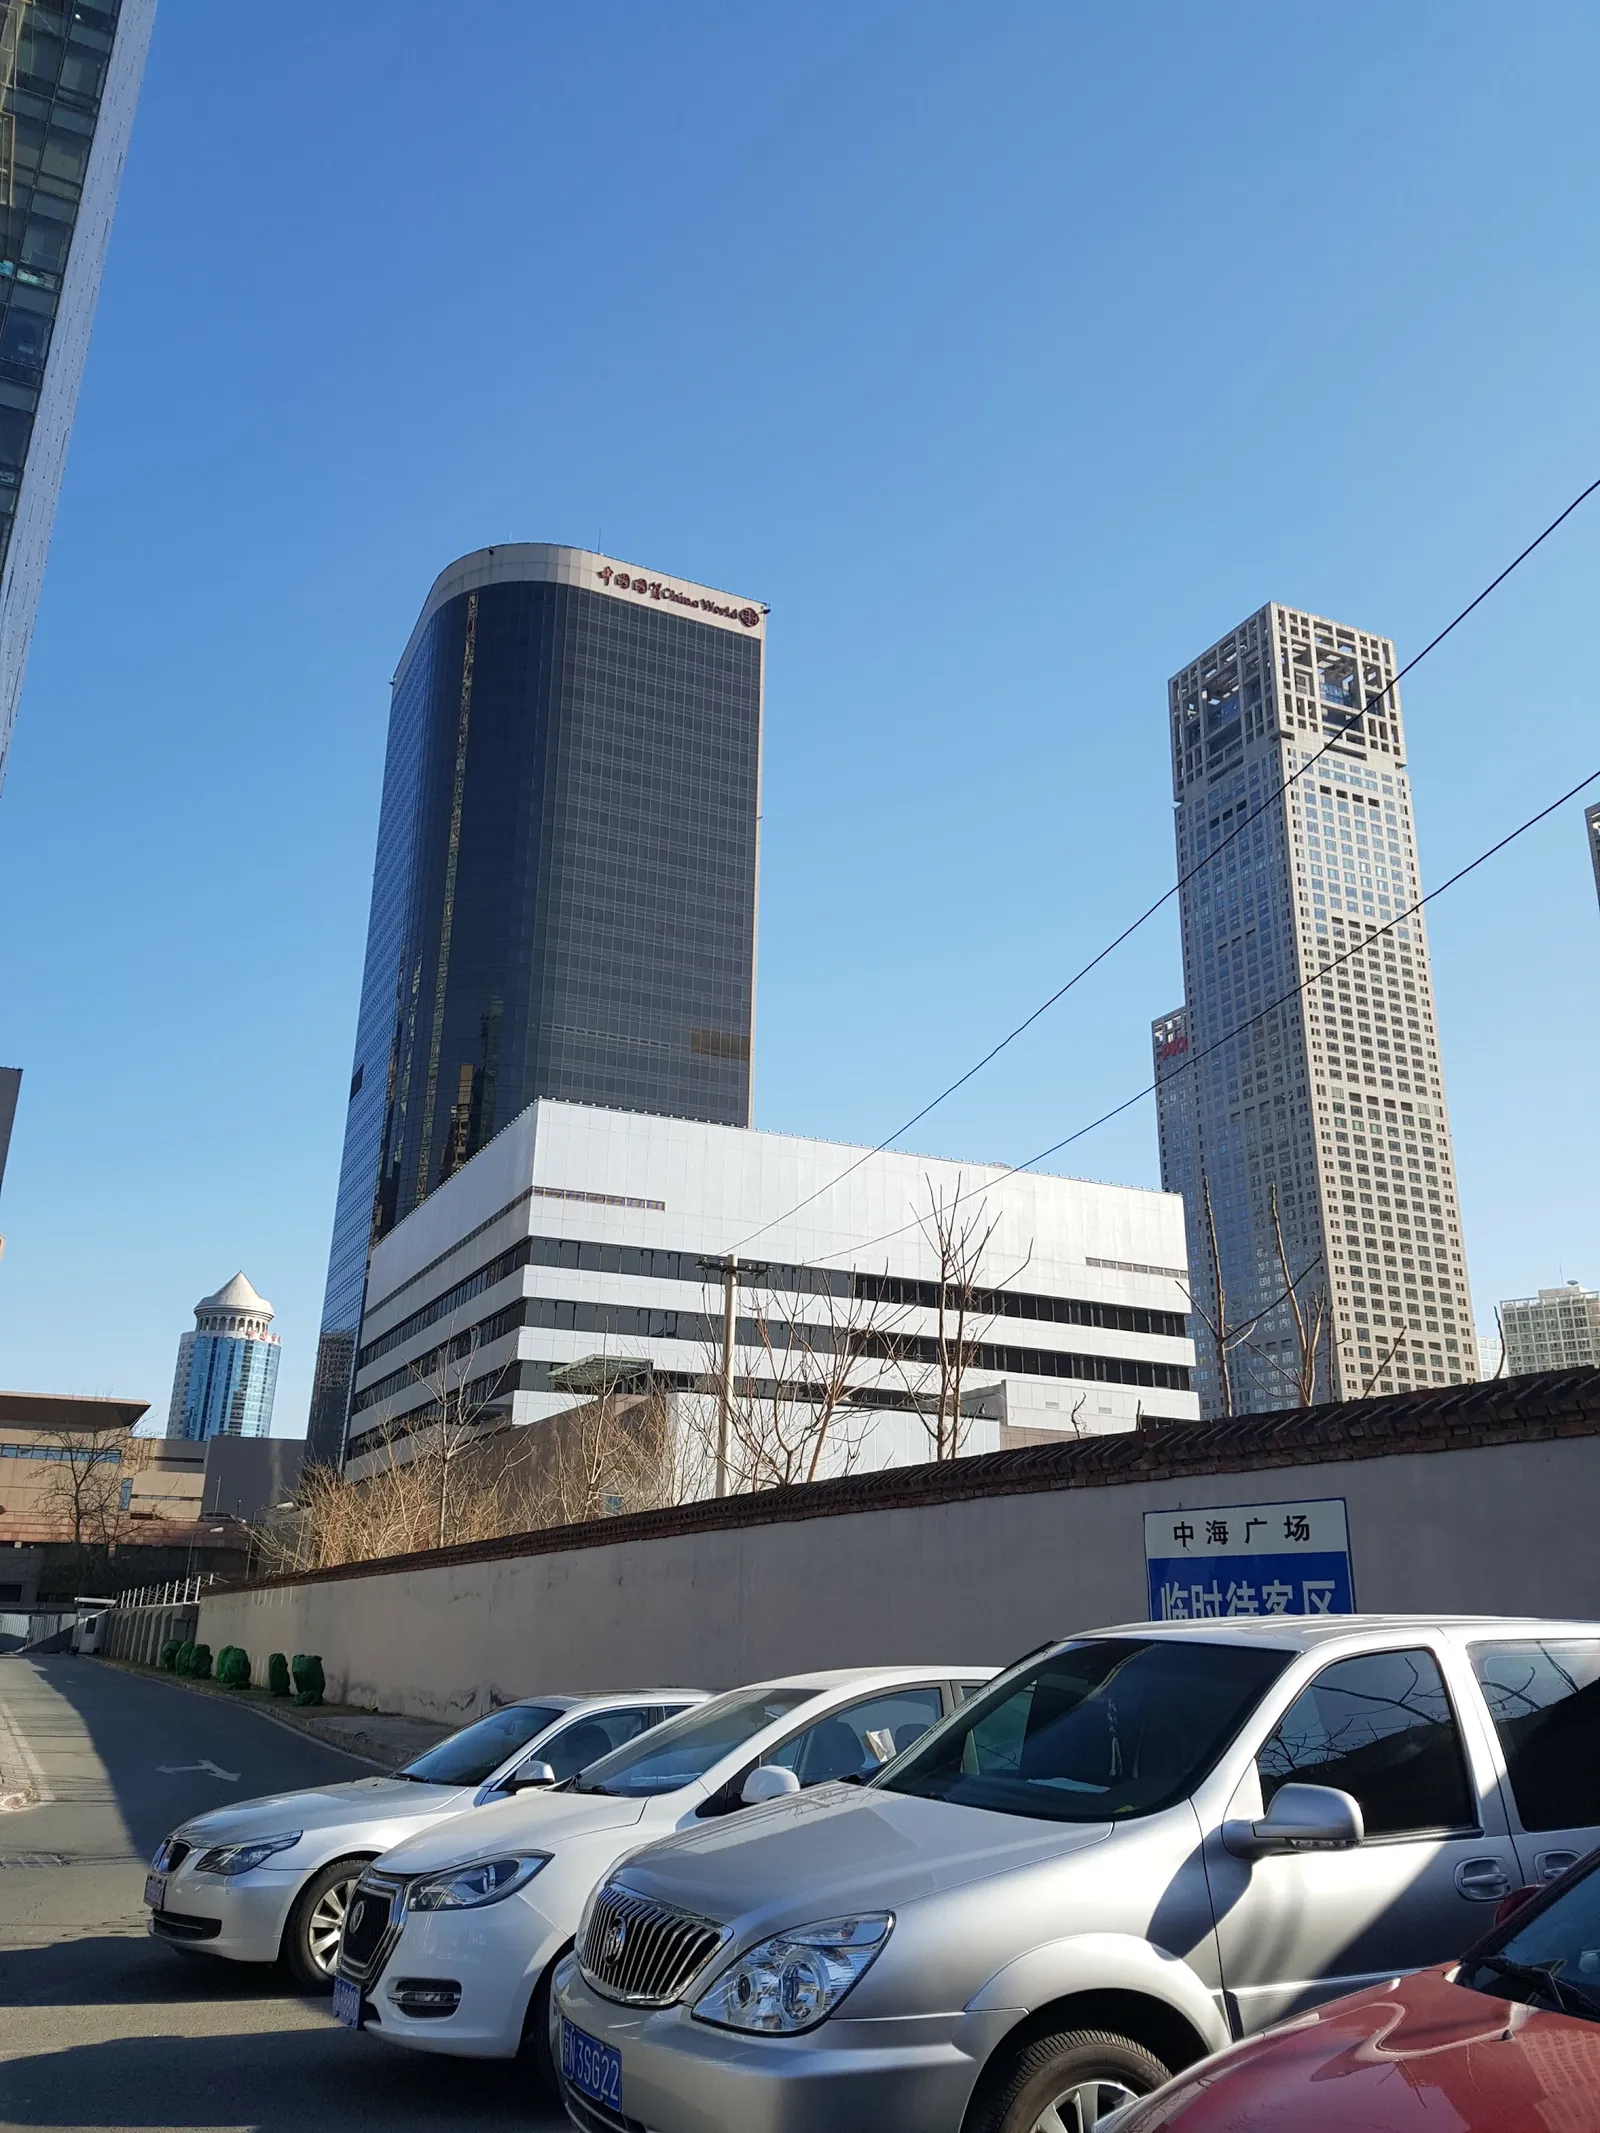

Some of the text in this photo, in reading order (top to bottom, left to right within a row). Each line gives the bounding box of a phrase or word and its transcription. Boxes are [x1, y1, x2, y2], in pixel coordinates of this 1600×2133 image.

[661, 588, 739, 620] China World
[1173, 1514, 1310, 1547] 中海广场
